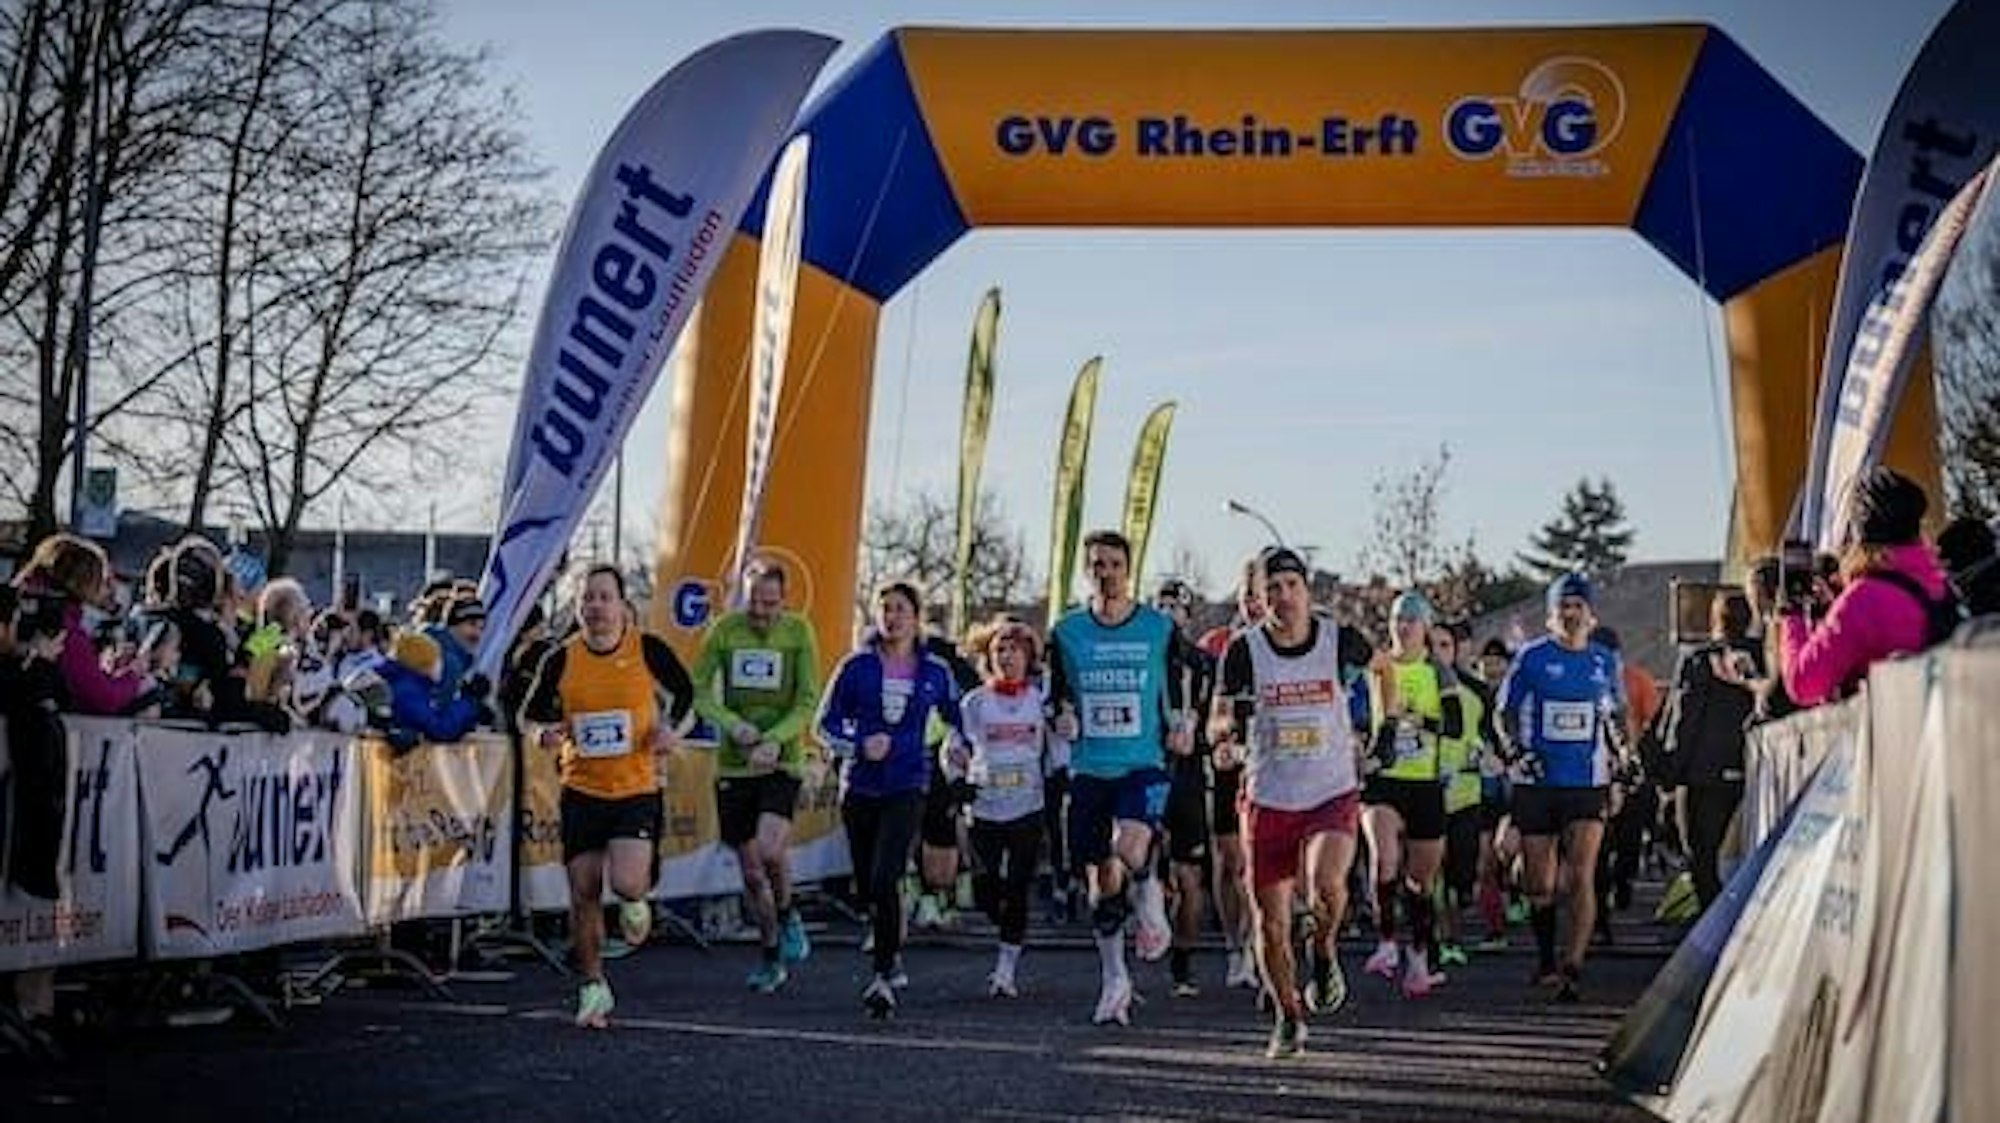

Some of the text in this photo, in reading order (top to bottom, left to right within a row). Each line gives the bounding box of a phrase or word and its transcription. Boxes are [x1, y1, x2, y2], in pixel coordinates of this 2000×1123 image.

[996, 114, 1418, 159] GVG Rhein-Erft
[1446, 97, 1599, 160] GVG
